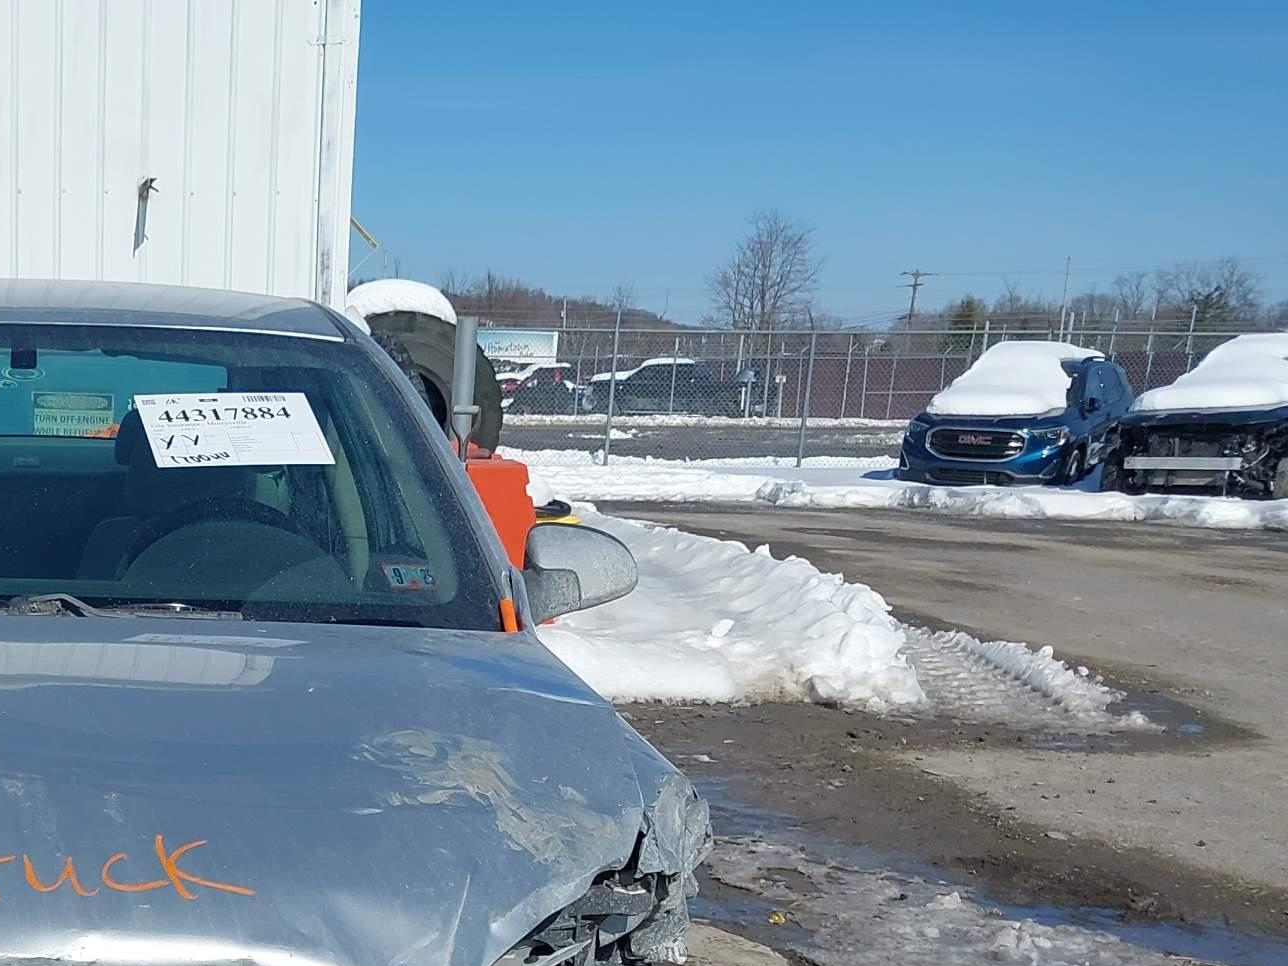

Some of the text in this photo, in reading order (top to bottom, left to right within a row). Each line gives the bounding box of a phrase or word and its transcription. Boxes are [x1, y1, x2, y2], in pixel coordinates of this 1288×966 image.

[35, 414, 58, 423] TURN
[158, 406, 291, 423] 44317884
[958, 435, 992, 445] GMC
